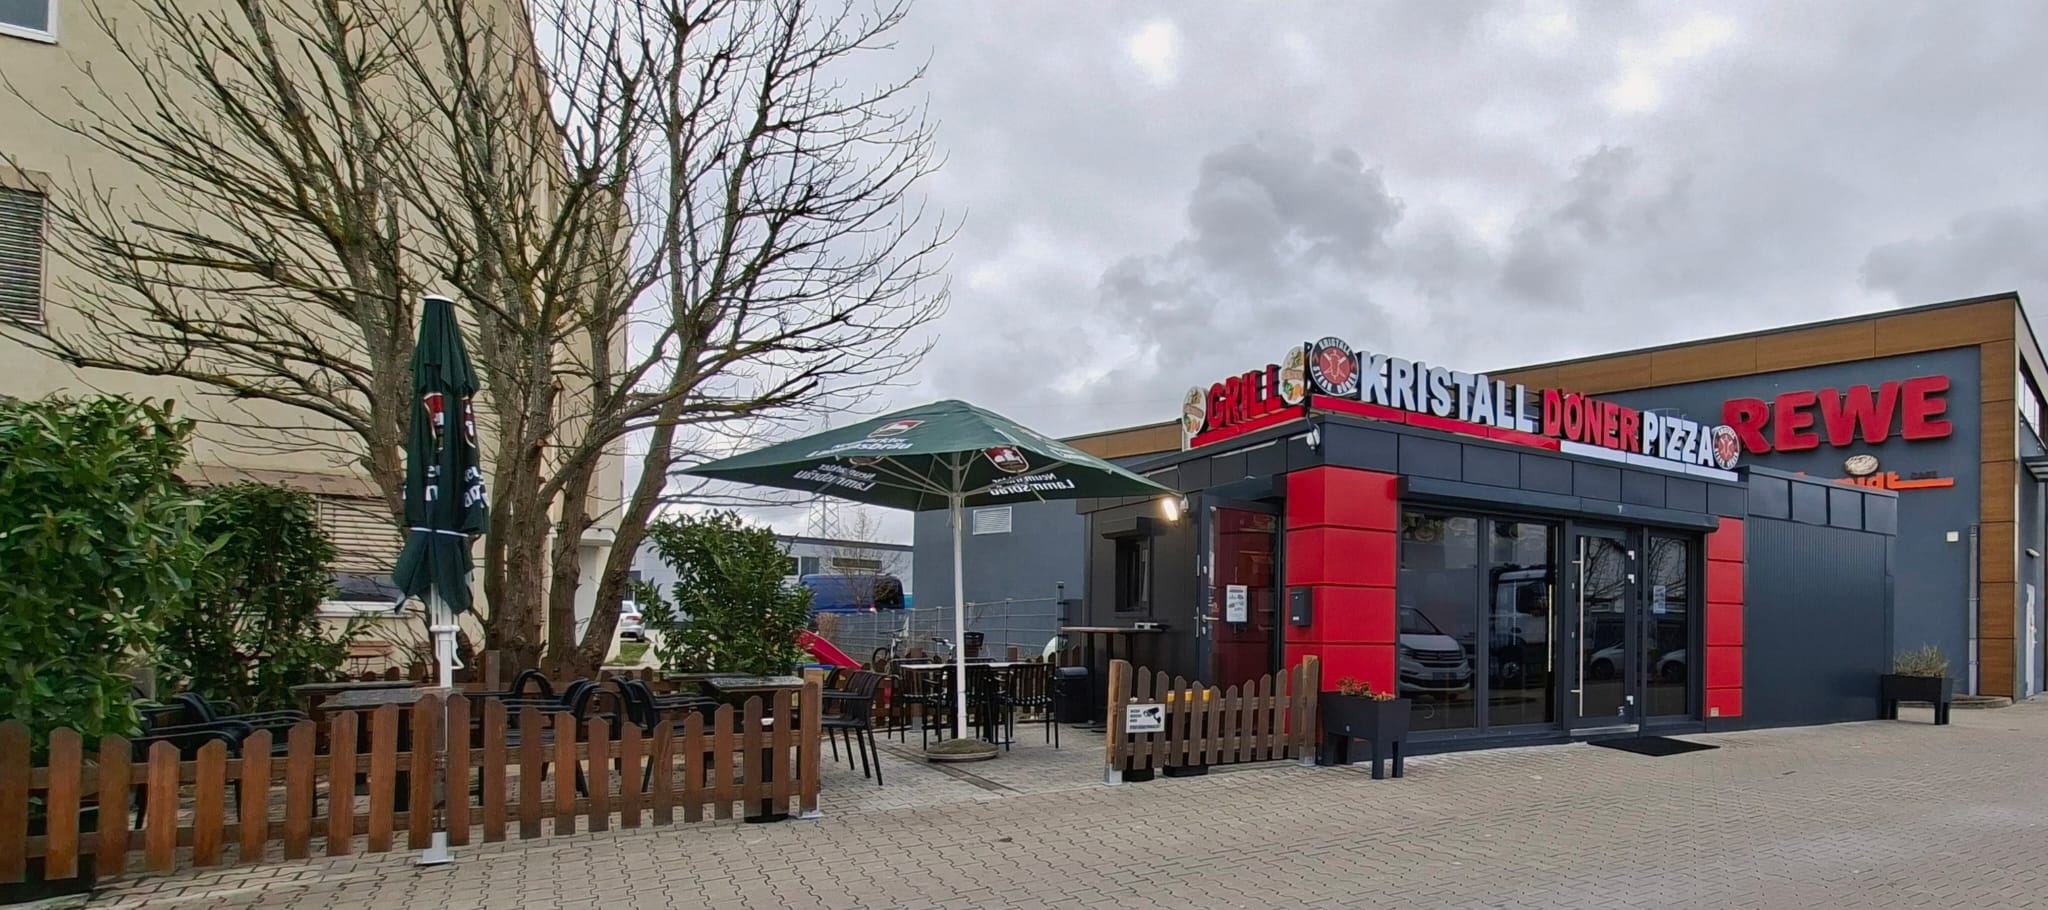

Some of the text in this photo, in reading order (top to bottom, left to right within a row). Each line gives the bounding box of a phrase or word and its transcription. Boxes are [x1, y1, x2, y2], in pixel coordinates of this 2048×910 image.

[1207, 364, 1281, 428] GRILL
[1359, 350, 1535, 433] KRISTALL
[1543, 389, 1640, 452] DÖNER
[1643, 412, 1714, 468] PIZZA
[1722, 375, 1953, 454] REWE
